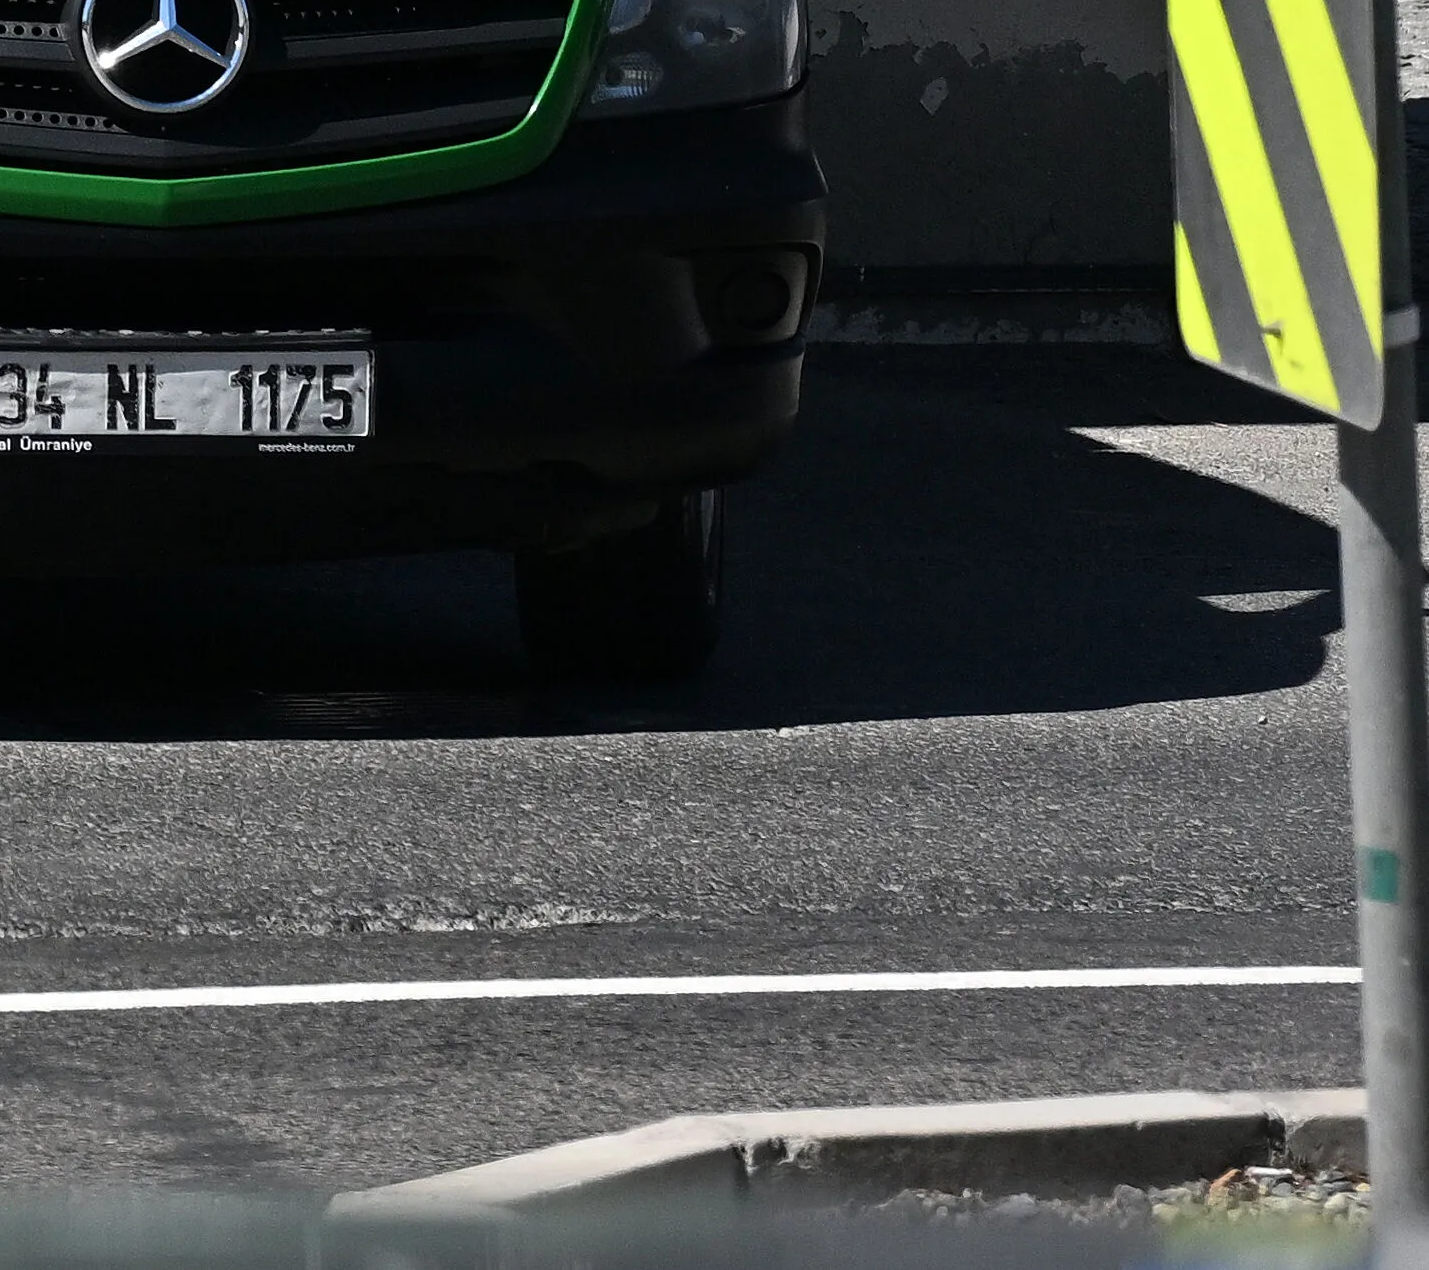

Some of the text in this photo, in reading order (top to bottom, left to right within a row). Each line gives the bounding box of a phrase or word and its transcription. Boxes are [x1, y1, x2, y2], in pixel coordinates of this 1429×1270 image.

[107, 364, 177, 430] NL
[229, 364, 354, 431] 1175
[20, 435, 92, 453] Ümraniye
